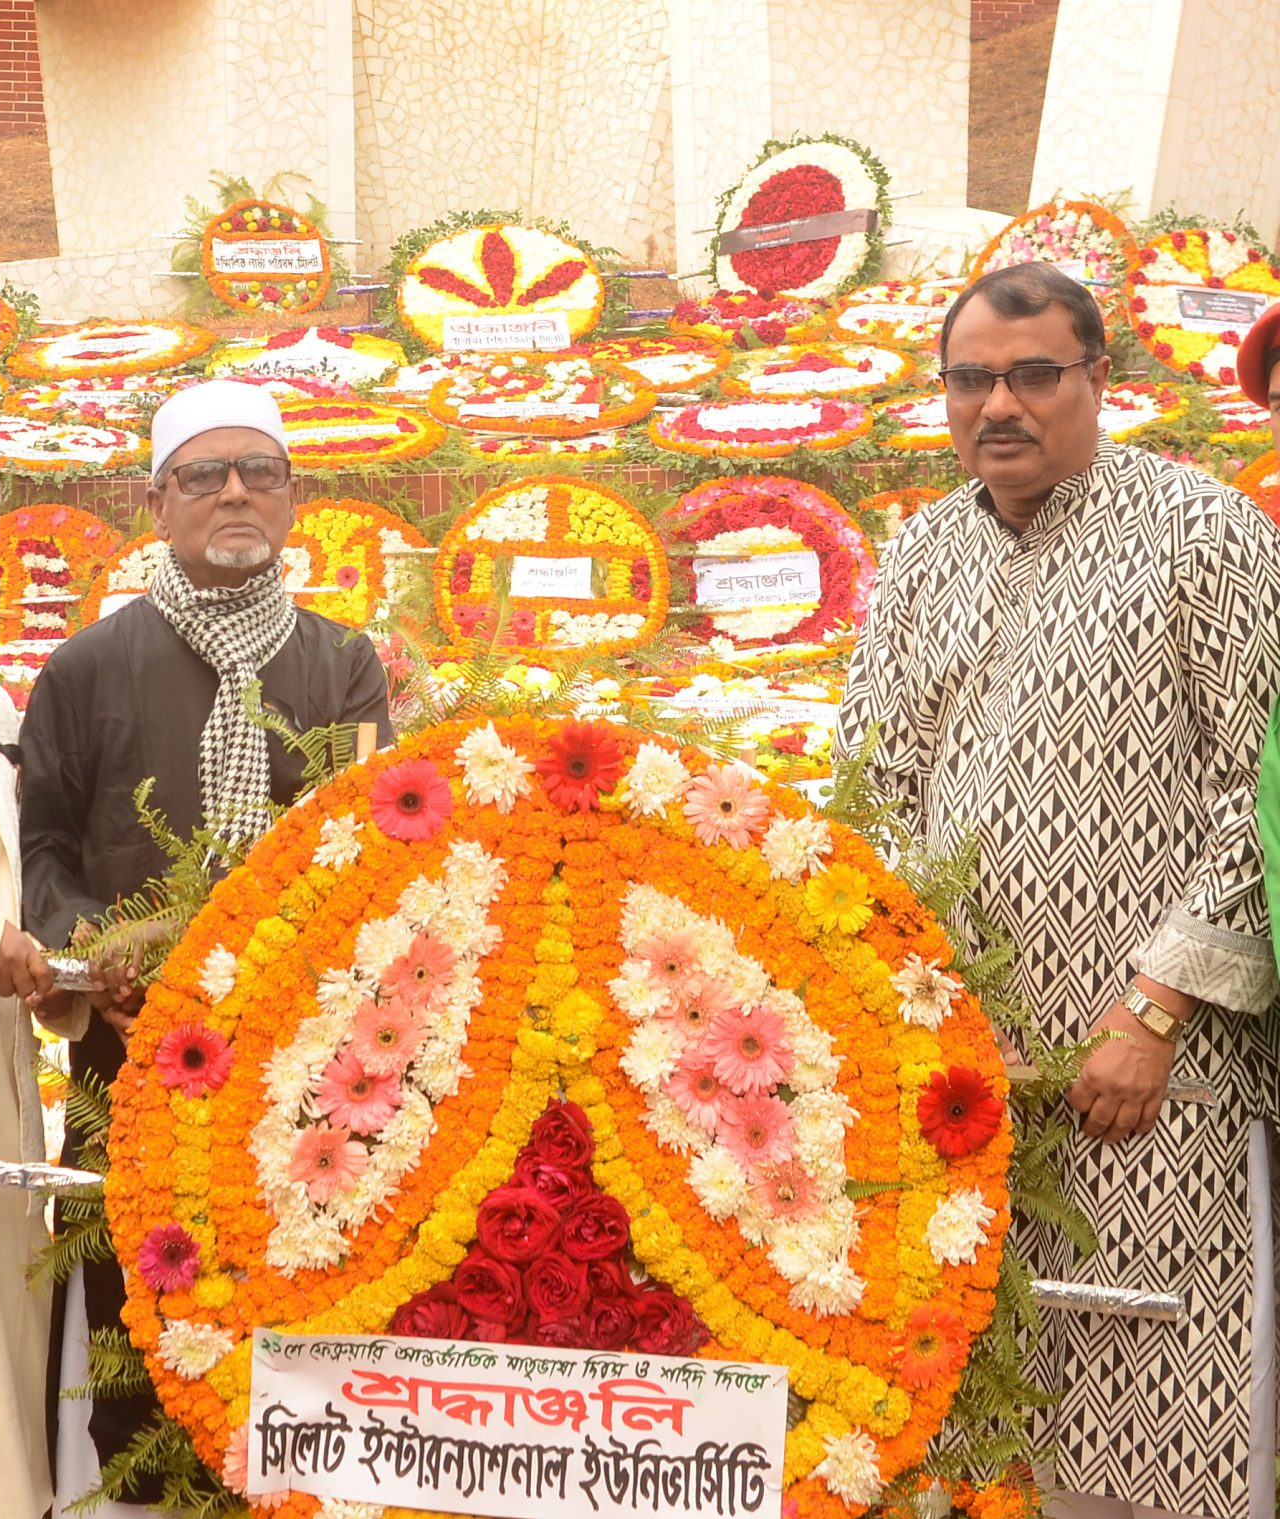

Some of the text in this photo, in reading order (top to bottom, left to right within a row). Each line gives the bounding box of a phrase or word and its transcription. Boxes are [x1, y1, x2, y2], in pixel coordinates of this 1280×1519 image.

[715, 567, 804, 591] শ্রদ্ধাঞ্জলি
[310, 1339, 397, 1365] ফেব্রুয়ারি
[395, 1344, 499, 1369] আন্তর্জাতিক
[582, 1353, 629, 1380] দিবস
[634, 1359, 651, 1379] ও
[342, 1368, 697, 1437] শ্রদ্ধাঞ্জলি
[254, 1400, 772, 1517] সিলেট ইন্টারন্যাশনাল ইউনিভার্সিটি
